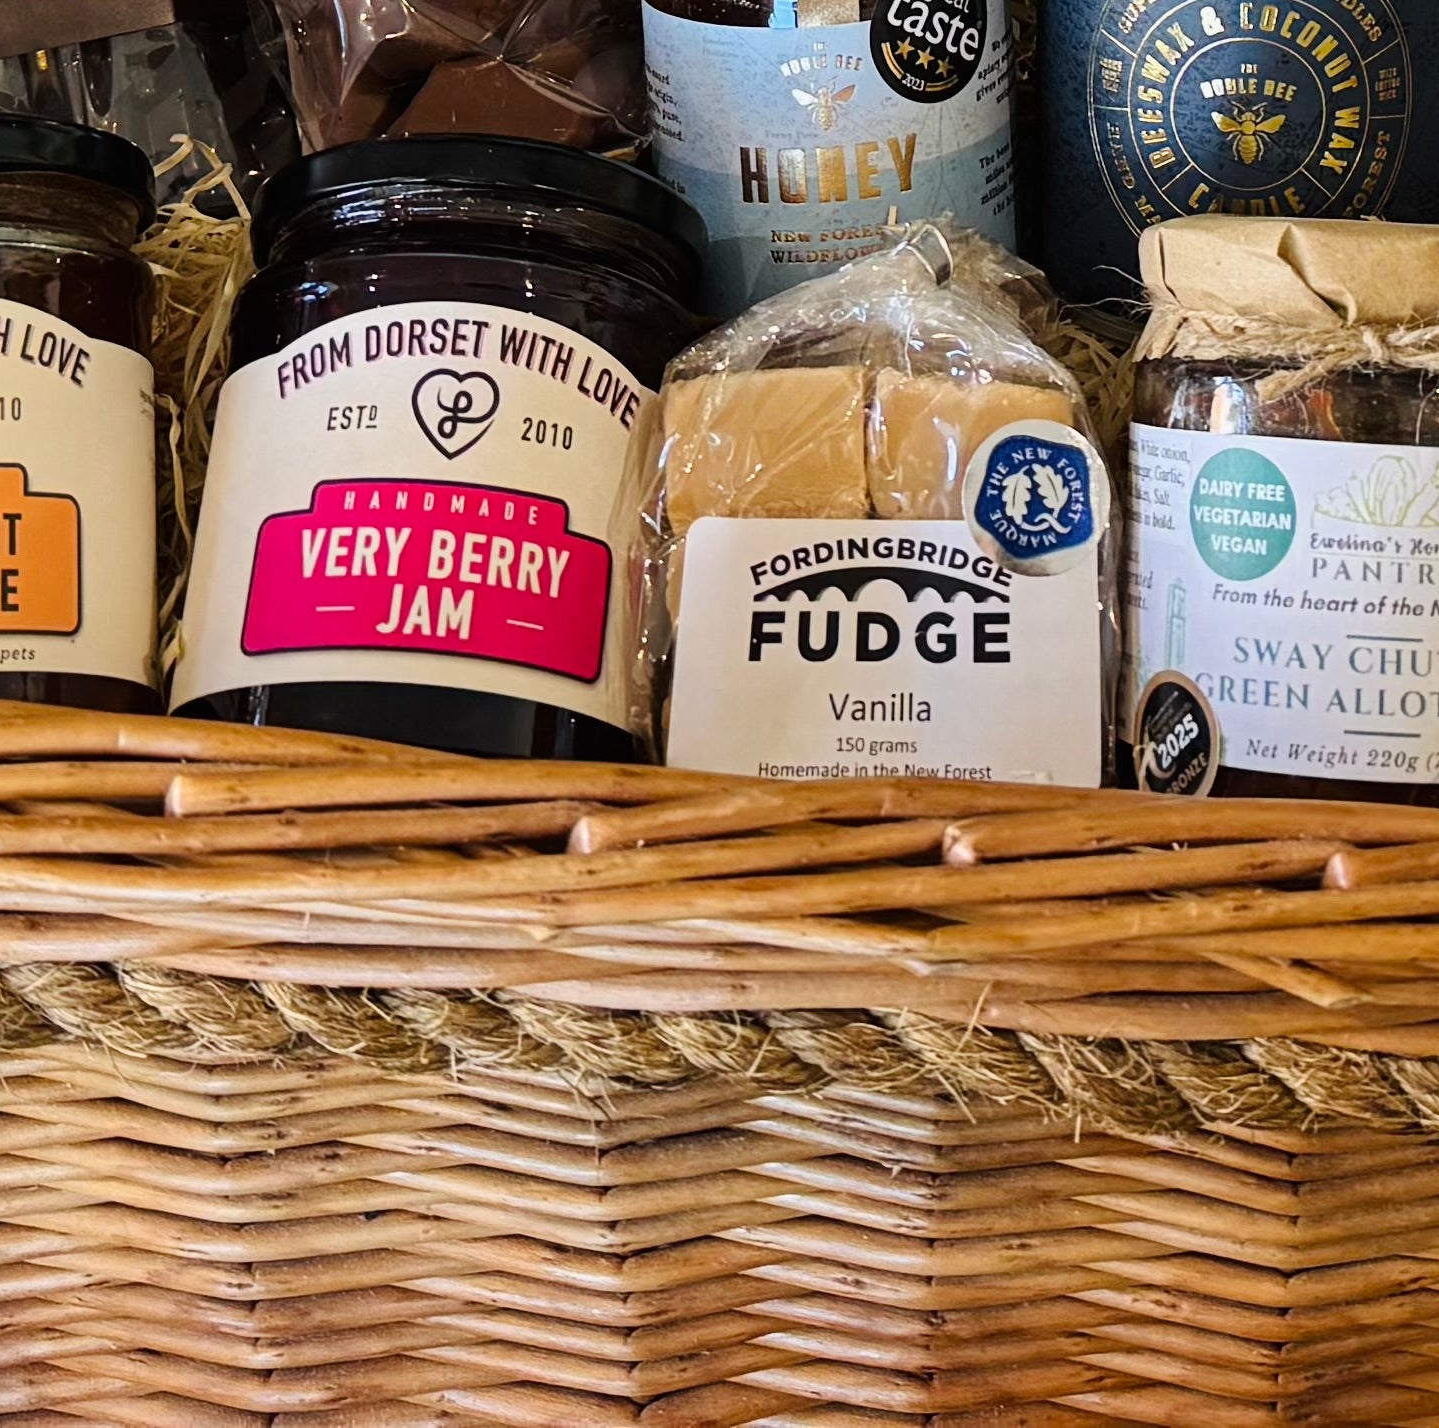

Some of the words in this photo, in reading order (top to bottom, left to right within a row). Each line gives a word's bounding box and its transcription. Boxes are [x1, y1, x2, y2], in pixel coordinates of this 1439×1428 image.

[739, 132, 917, 204] HONEY
[1199, 478, 1244, 498] DAIRY
[1248, 483, 1286, 502] FREE
[1193, 505, 1292, 530] VEGETARIAN
[1211, 535, 1267, 555] VEGAN
[301, 526, 412, 579] VERY
[427, 529, 572, 598] BERRY
[376, 583, 474, 640] JAM
[748, 610, 1012, 664] FUDGE
[1233, 636, 1333, 671] SWAY
[829, 692, 932, 722] Vanilla
[837, 737, 865, 752] 150
[869, 738, 918, 755] grams
